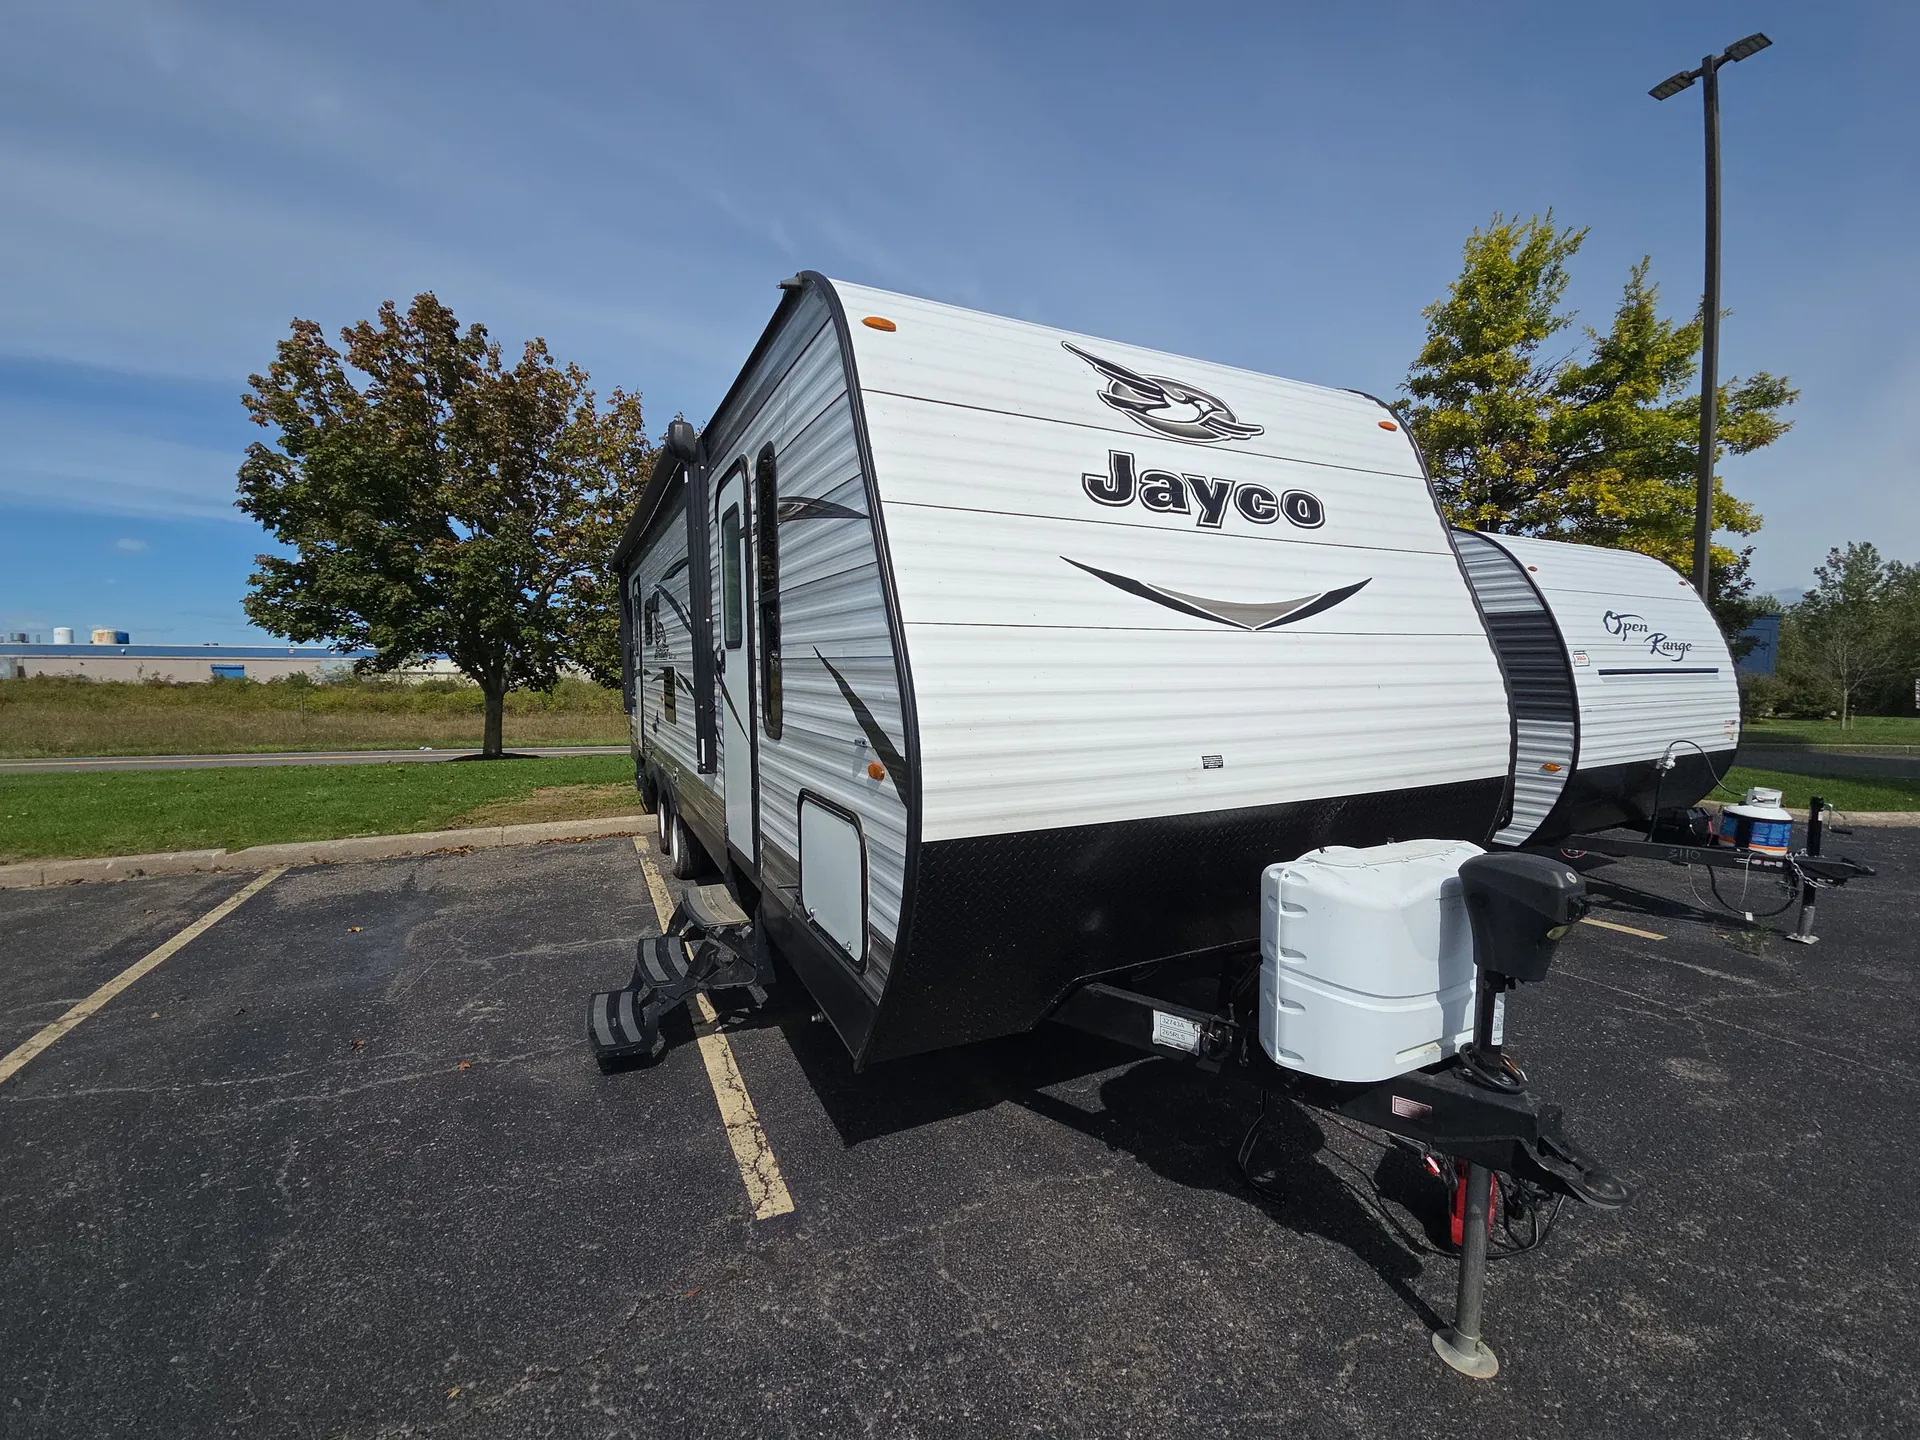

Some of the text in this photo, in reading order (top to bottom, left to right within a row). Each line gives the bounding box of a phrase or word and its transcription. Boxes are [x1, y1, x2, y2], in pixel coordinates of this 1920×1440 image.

[1081, 449, 1326, 529] Jayco
[1602, 610, 1649, 642] Open
[1644, 632, 1693, 662] Range
[1161, 1029, 1186, 1041] 265RLS
